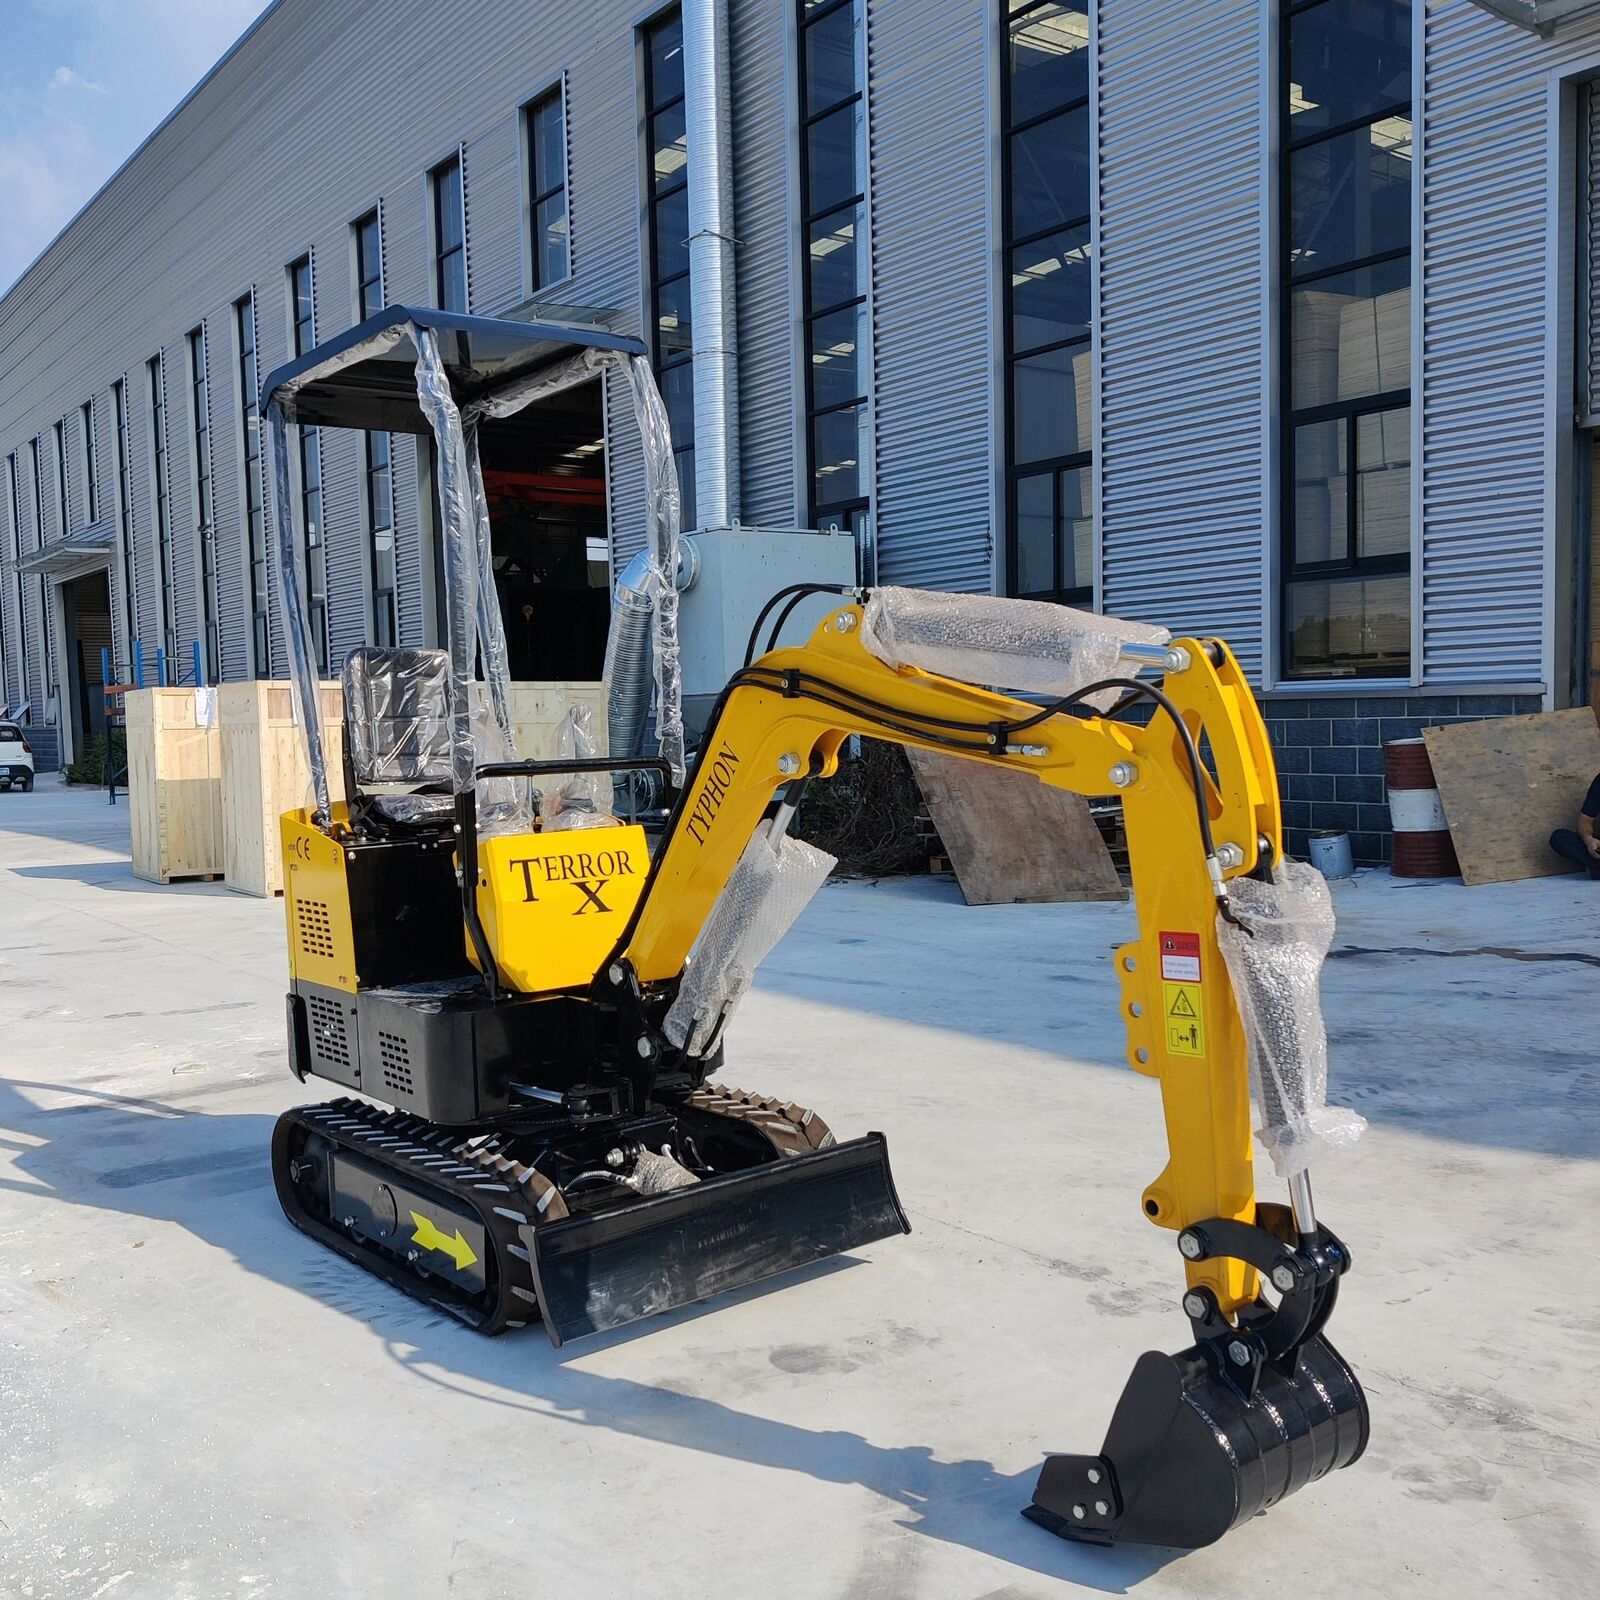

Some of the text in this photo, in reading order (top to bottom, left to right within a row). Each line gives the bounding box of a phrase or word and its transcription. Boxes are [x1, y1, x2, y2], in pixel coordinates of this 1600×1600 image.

[685, 740, 740, 847] TYPHON
[296, 836, 311, 861] CE
[509, 850, 635, 902] TERROR
[570, 879, 613, 916] X
